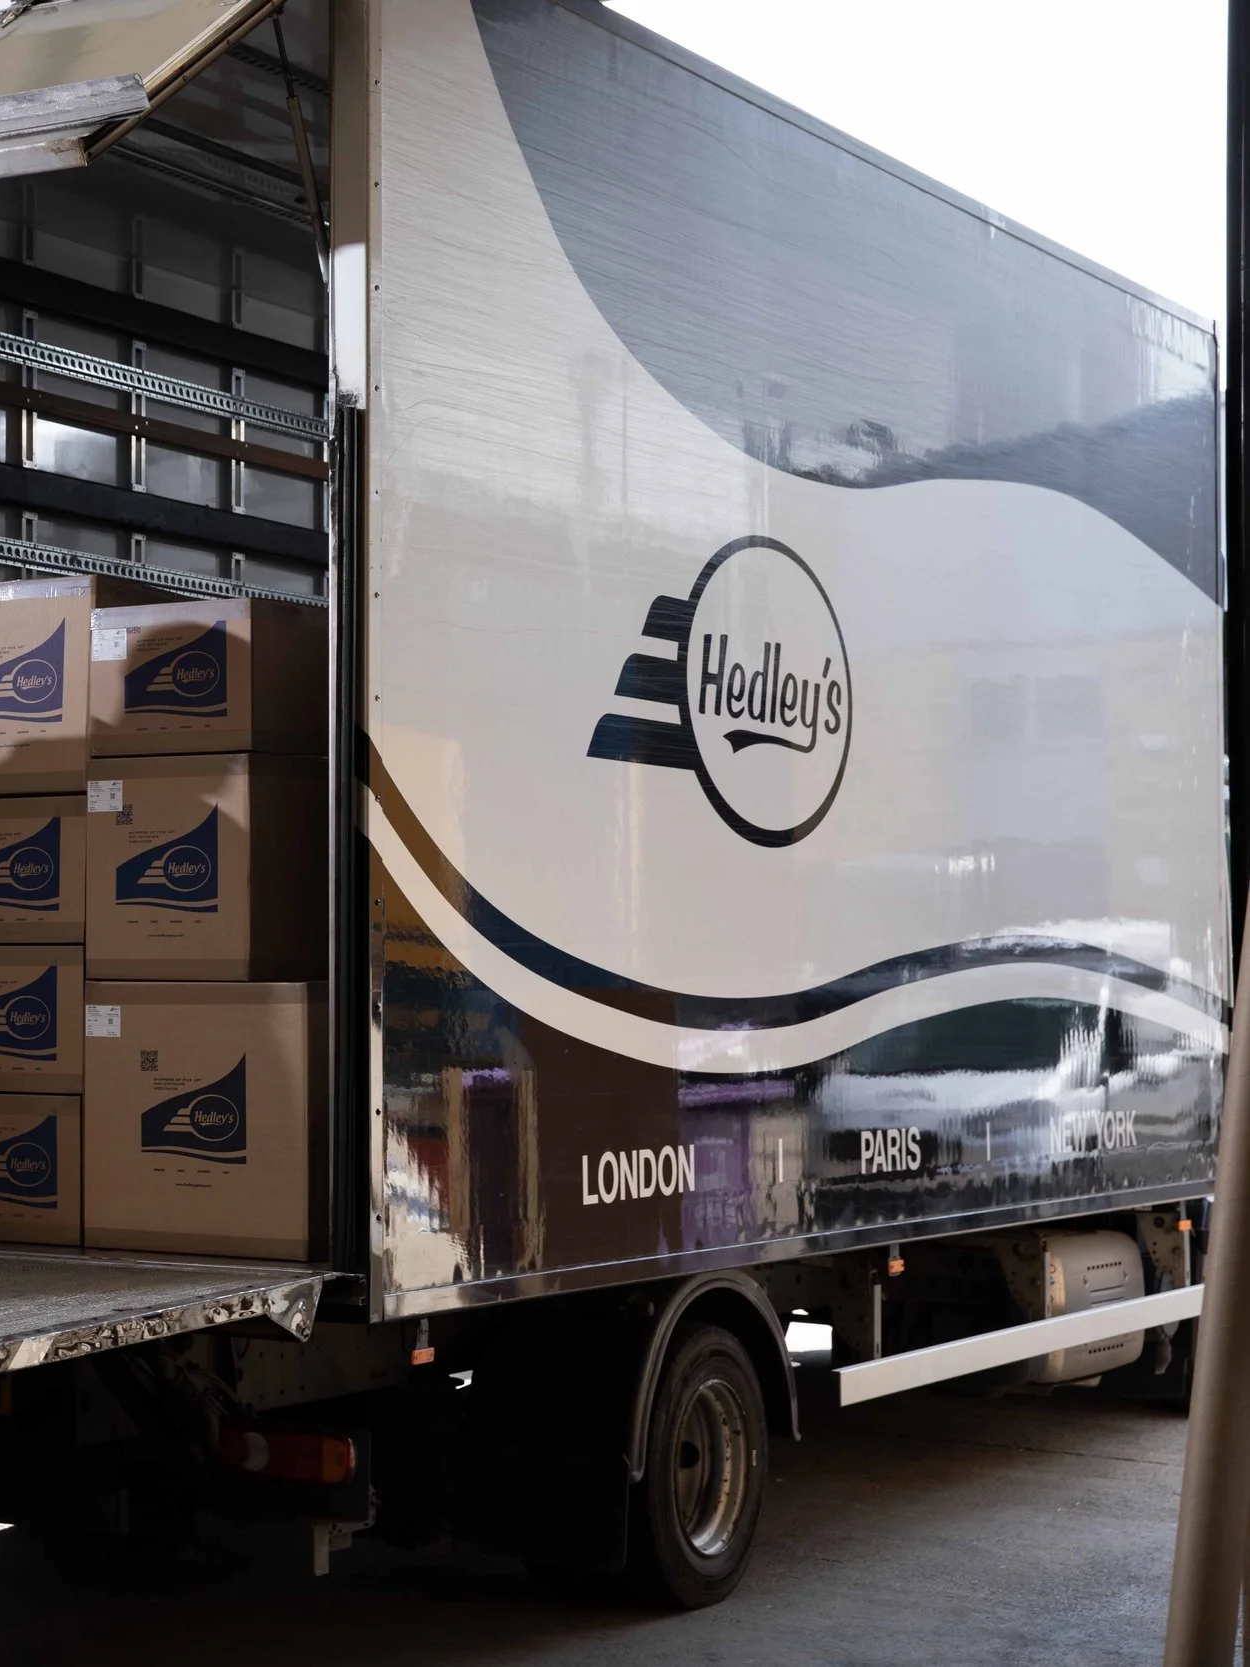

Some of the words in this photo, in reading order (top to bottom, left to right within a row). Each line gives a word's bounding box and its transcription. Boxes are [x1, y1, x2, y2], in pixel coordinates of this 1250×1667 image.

[16, 674, 52, 691] Hedley's
[176, 667, 215, 683] Hedley's
[698, 634, 842, 753] Hedley's
[13, 861, 49, 877] Hedley's
[168, 861, 206, 877] Hedley's
[10, 1010, 46, 1027] Hedley's
[194, 1110, 234, 1127] Hedley's
[10, 1157, 46, 1173] Hedley's
[582, 1144, 695, 1206] LONDON
[860, 1126, 922, 1174] PARIS
[1050, 1114, 1087, 1154] NEW
[1091, 1109, 1138, 1150] YORK
